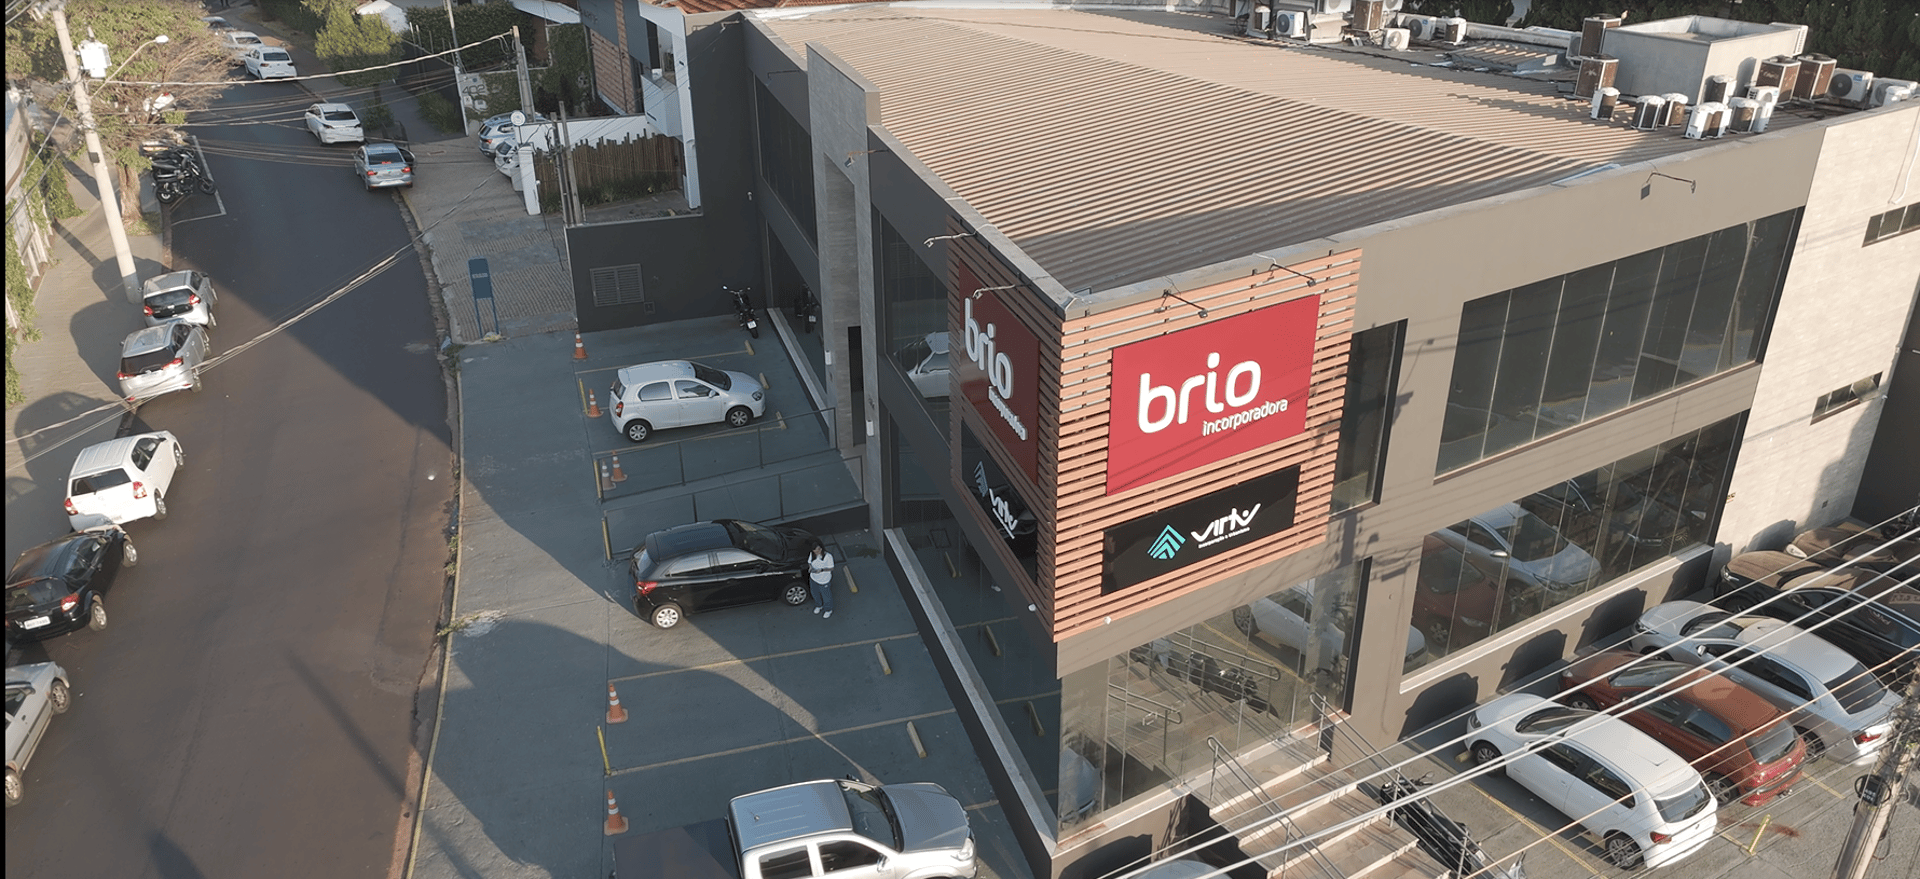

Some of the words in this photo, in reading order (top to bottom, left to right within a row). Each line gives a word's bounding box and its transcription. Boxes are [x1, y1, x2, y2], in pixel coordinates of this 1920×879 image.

[964, 297, 1014, 400] brio
[1138, 352, 1262, 434] brio
[1202, 399, 1289, 437] incorporadora
